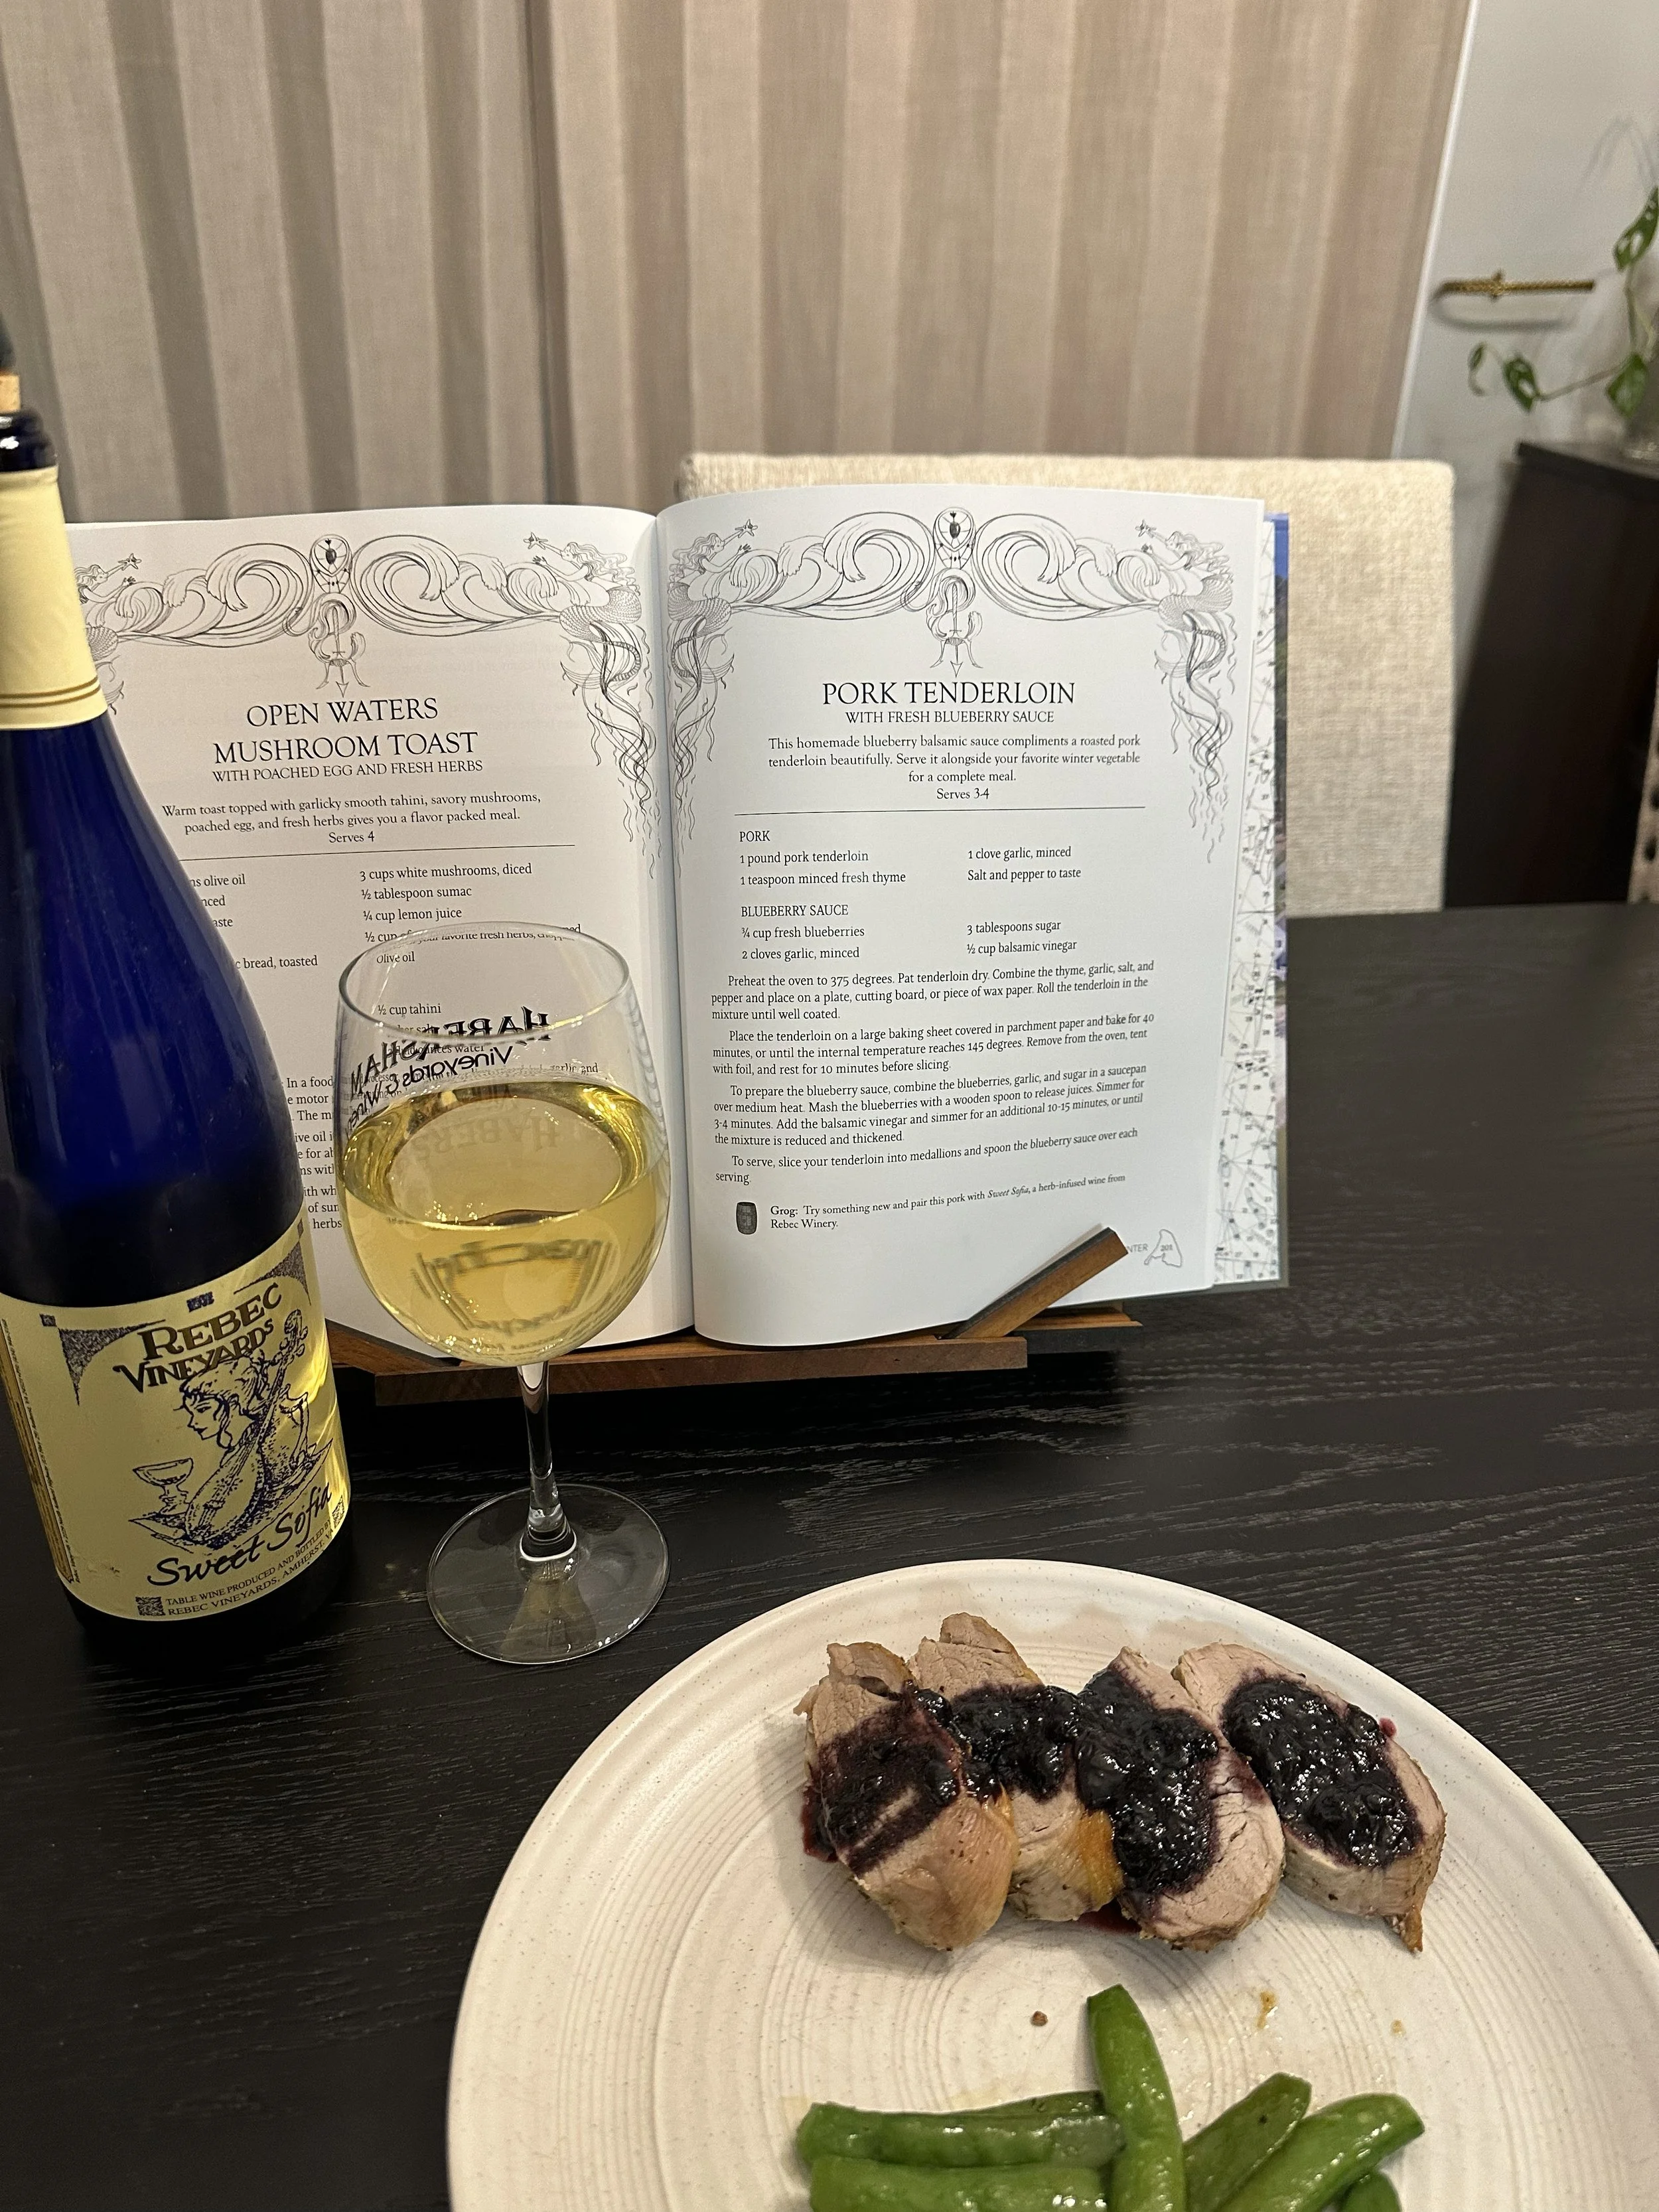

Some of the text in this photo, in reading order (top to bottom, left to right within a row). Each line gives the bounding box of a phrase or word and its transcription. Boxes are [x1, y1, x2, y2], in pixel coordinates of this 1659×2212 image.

[822, 681, 1075, 705] PORK TENDERLOIN
[246, 697, 438, 727] OPEN WATERS
[845, 710, 1054, 723] WITH FRESH BLUEBERRY SAUCE
[212, 730, 478, 764] MUSHROOM TOAST
[768, 737, 793, 749] This
[796, 735, 859, 749] homemade
[863, 734, 917, 749] blueberry
[920, 733, 967, 747] balsamic
[1002, 733, 1068, 749] compliments
[1080, 733, 1115, 746] roasted
[1118, 734, 1140, 748] pork
[768, 751, 1140, 767] tenderloin beautifully. Serve it alongside your favorite winter vegetable
[212, 759, 483, 782] WITH POACHED EGG AND FRESH HERBS
[908, 770, 924, 782] for
[936, 769, 985, 784] complete
[989, 769, 1016, 781] meal.
[936, 787, 970, 799] Serves
[161, 789, 541, 816] Warm toast topped with garlicky smooth tahini, savory mushrooms,
[184, 819, 230, 835] poached
[233, 821, 255, 833] egg,
[257, 816, 279, 829] and
[282, 814, 310, 828] fresh
[313, 813, 344, 827] herbs
[347, 814, 374, 828] gives
[376, 815, 397, 828] you
[410, 809, 443, 823] flavor
[446, 808, 486, 824] packed
[489, 807, 520, 820] meal.
[328, 830, 375, 844] Serves 4
[739, 830, 770, 842] PORK
[739, 849, 869, 867] 1 pound pork tenderloin
[968, 845, 1071, 862] 1 clove garlic, minced
[203, 873, 246, 887] olive oil
[359, 861, 532, 883] 3 cups white mushrooms, diced
[740, 871, 906, 889] 1 teaspoon minced fresh thyme
[968, 868, 1081, 883] Salt and pepper to taste
[374, 886, 433, 903] tablespoon
[436, 887, 472, 897] sumac
[375, 912, 395, 924] cup
[397, 907, 433, 920] lemon
[435, 907, 462, 922] juice
[741, 903, 849, 917] BLUEBERRY SAUCE
[753, 930, 772, 942] cup
[774, 926, 801, 938] fresh
[804, 924, 865, 938] blueberries
[966, 920, 1061, 935] 3 tablespoons sugar
[741, 946, 859, 962] 2 cloves garlic, minced
[977, 945, 996, 957] cup
[998, 940, 1040, 953] balsamic
[1041, 939, 1077, 954] vinegar
[388, 1006, 407, 1017] cup
[409, 1001, 441, 1015] tahini
[770, 1203, 798, 1219] Grog:
[802, 1204, 820, 1218] Try
[822, 1201, 870, 1217] something
[872, 1203, 891, 1212] new
[893, 1198, 908, 1210] and
[910, 1197, 928, 1211] pair
[929, 1195, 944, 1206] this
[946, 1193, 966, 1207] pork
[967, 1190, 985, 1201] with
[987, 1188, 1009, 1199] Sweet
[1010, 1184, 1031, 1198] Sofia,
[1038, 1177, 1086, 1191] herb-infused
[1087, 1177, 1106, 1185] wine
[1107, 1173, 1125, 1183] from
[770, 1218, 838, 1230] Rebec Winery.
[137, 1282, 282, 1361] REBEC
[113, 1318, 274, 1393] VINEYARDS
[147, 1483, 332, 1585] Sweet Sofia
[165, 1593, 198, 1605] TABLE
[198, 1588, 226, 1601] WINE
[227, 1566, 275, 1593] PRODUCED
[277, 1554, 295, 1572] AND
[295, 1528, 325, 1558] BOTTLED
[167, 1603, 208, 1615] REBEC
